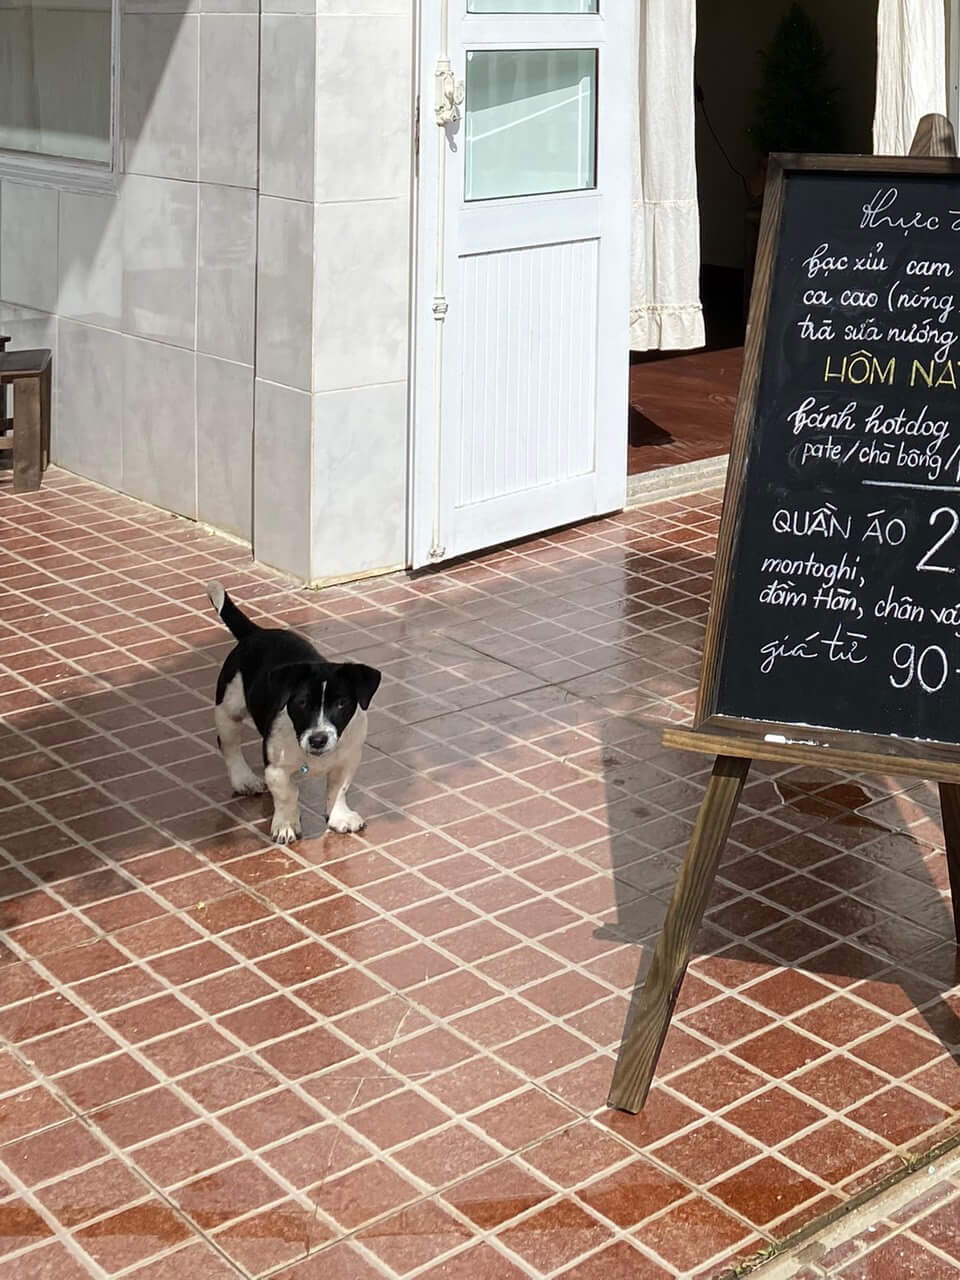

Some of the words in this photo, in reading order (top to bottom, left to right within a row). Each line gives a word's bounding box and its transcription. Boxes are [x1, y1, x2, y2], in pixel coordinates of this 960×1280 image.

[860, 188, 940, 236] thực
[802, 243, 848, 278] bạc
[906, 260, 953, 277] cam
[803, 289, 832, 305] ca
[840, 289, 878, 307] cao
[824, 349, 896, 385] HÔM
[787, 397, 856, 435] bánh
[865, 405, 950, 455] hotdog
[772, 503, 852, 539] QUẦN
[862, 509, 906, 545] ÁO
[761, 552, 865, 588] montoghi,
[875, 585, 924, 622] chân
[760, 631, 820, 673] giá
